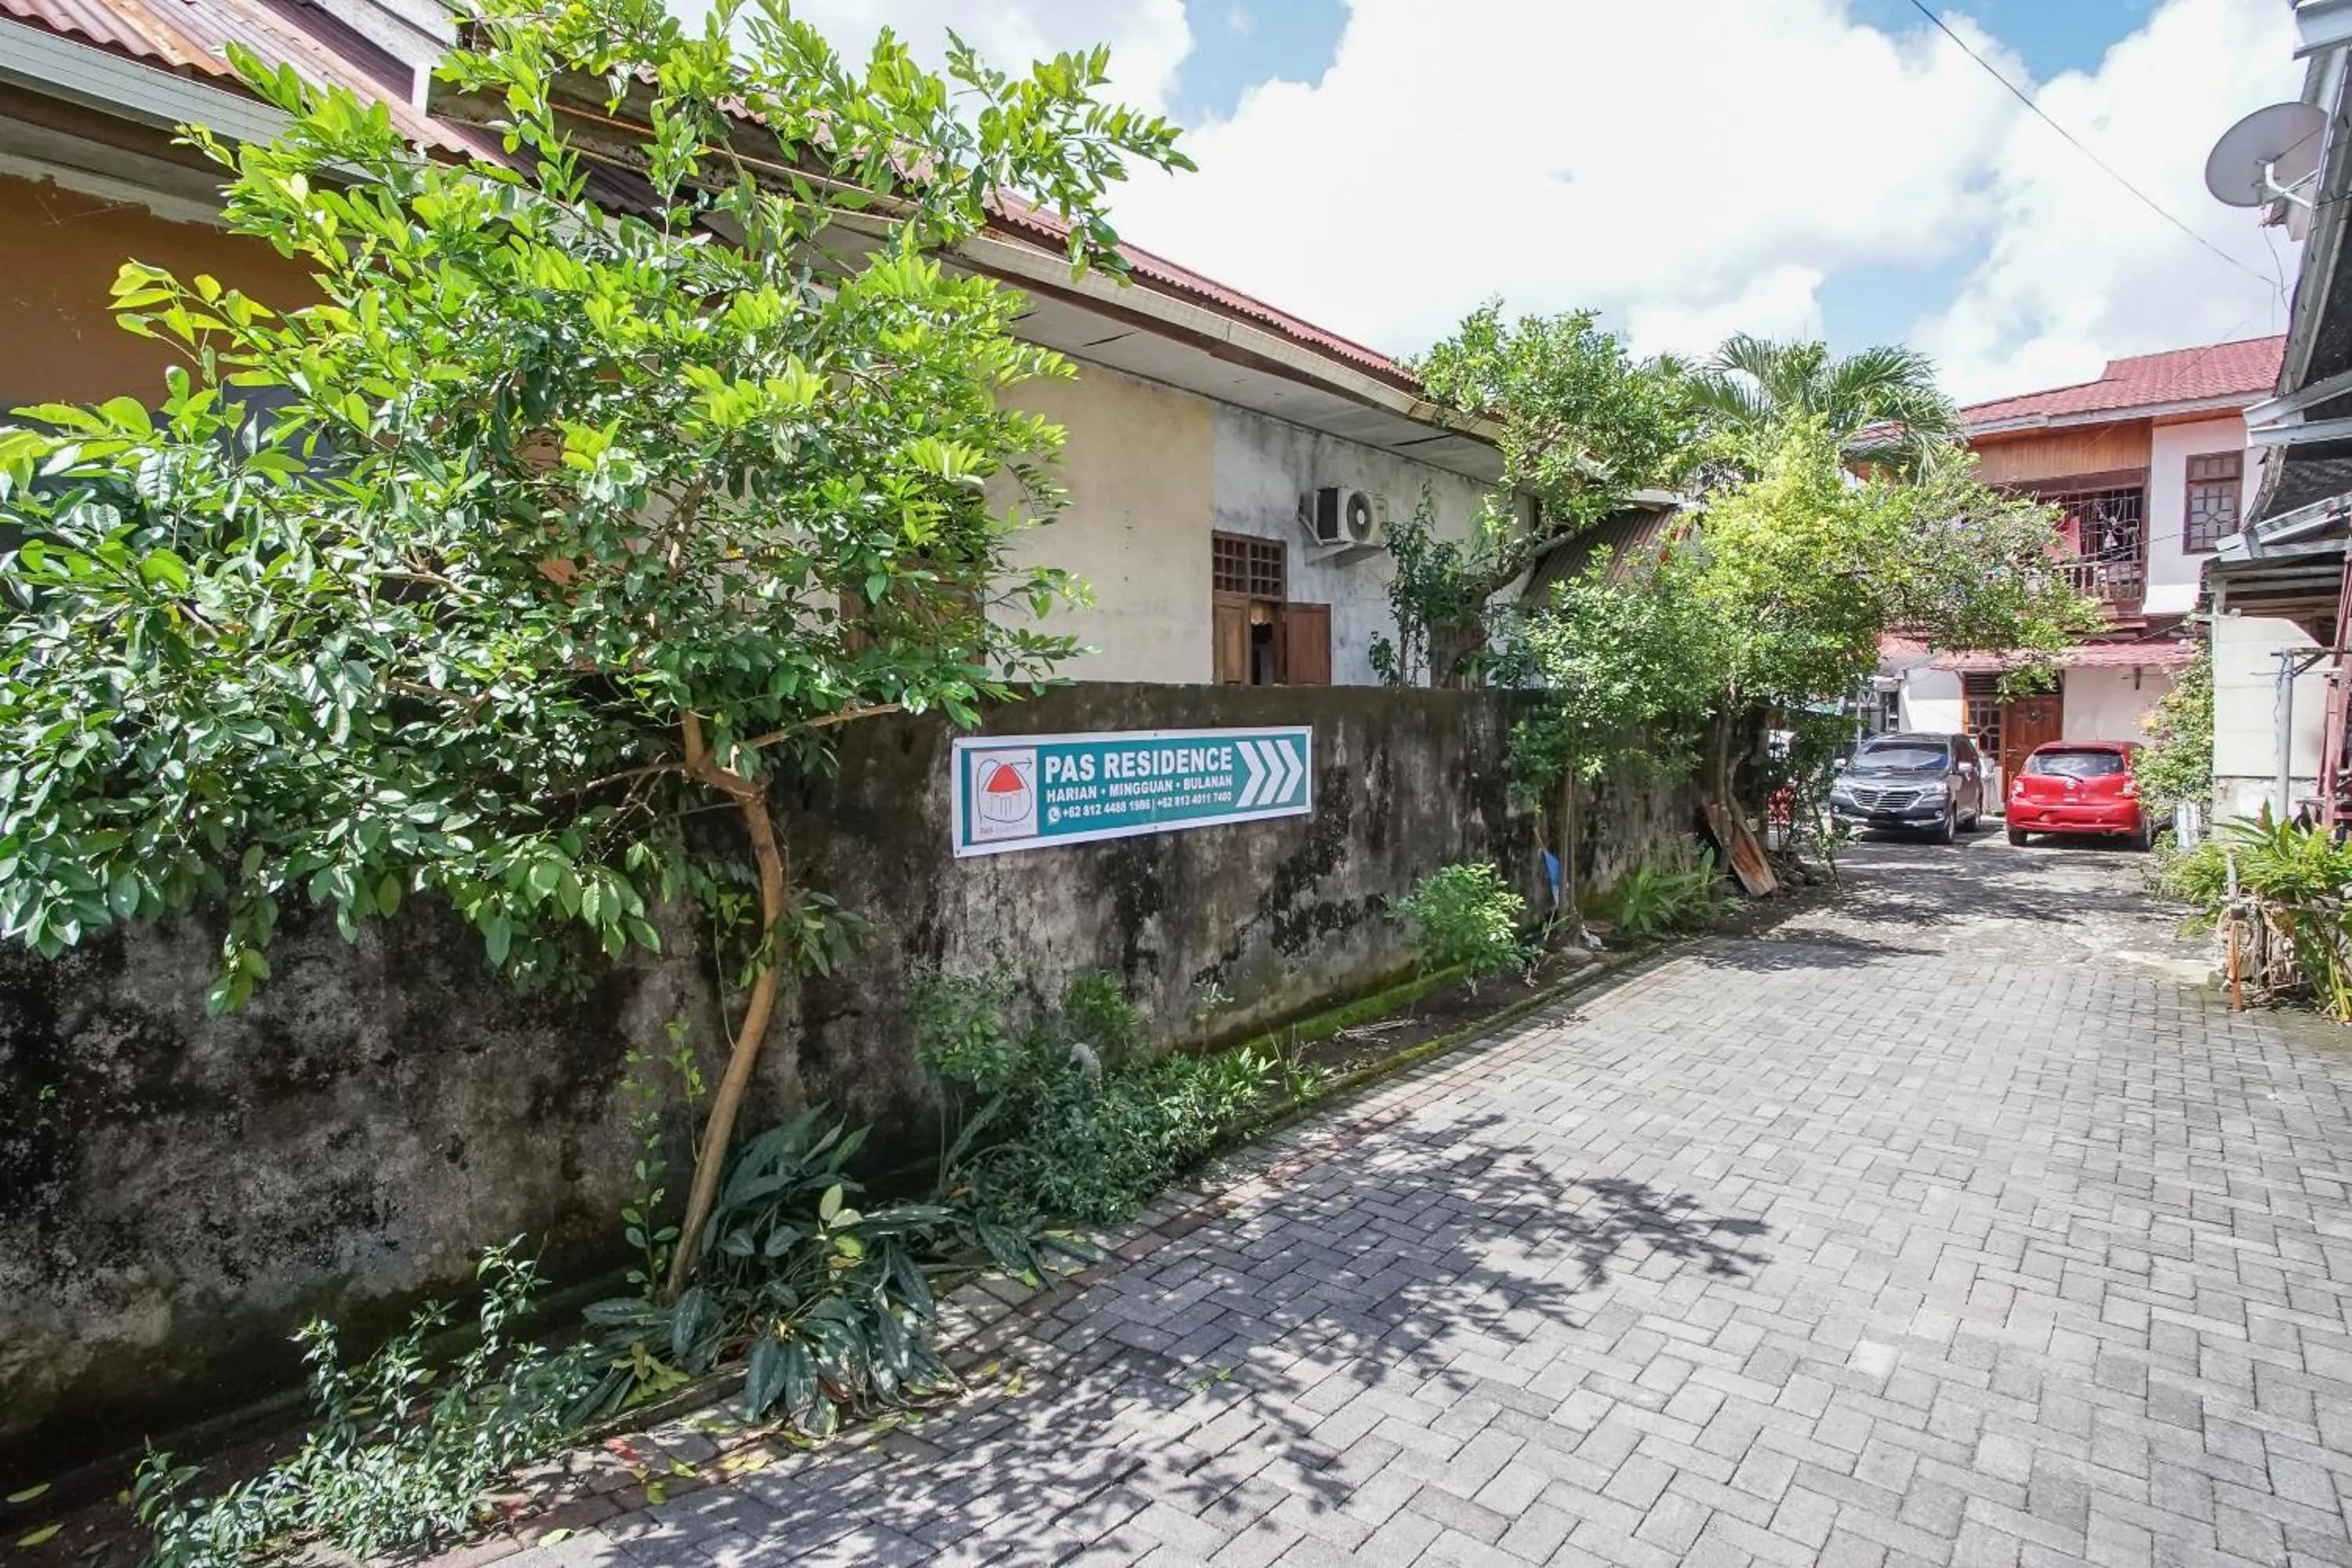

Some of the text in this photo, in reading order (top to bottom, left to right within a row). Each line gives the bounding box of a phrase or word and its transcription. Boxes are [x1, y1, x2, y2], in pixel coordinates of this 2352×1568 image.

[1045, 747, 1232, 783] PAS RESIDENCE
[1047, 775, 1232, 803] HARIAN MINGGUAN BULANAN
[1062, 806, 1081, 818] +62
[1083, 804, 1102, 816] 812
